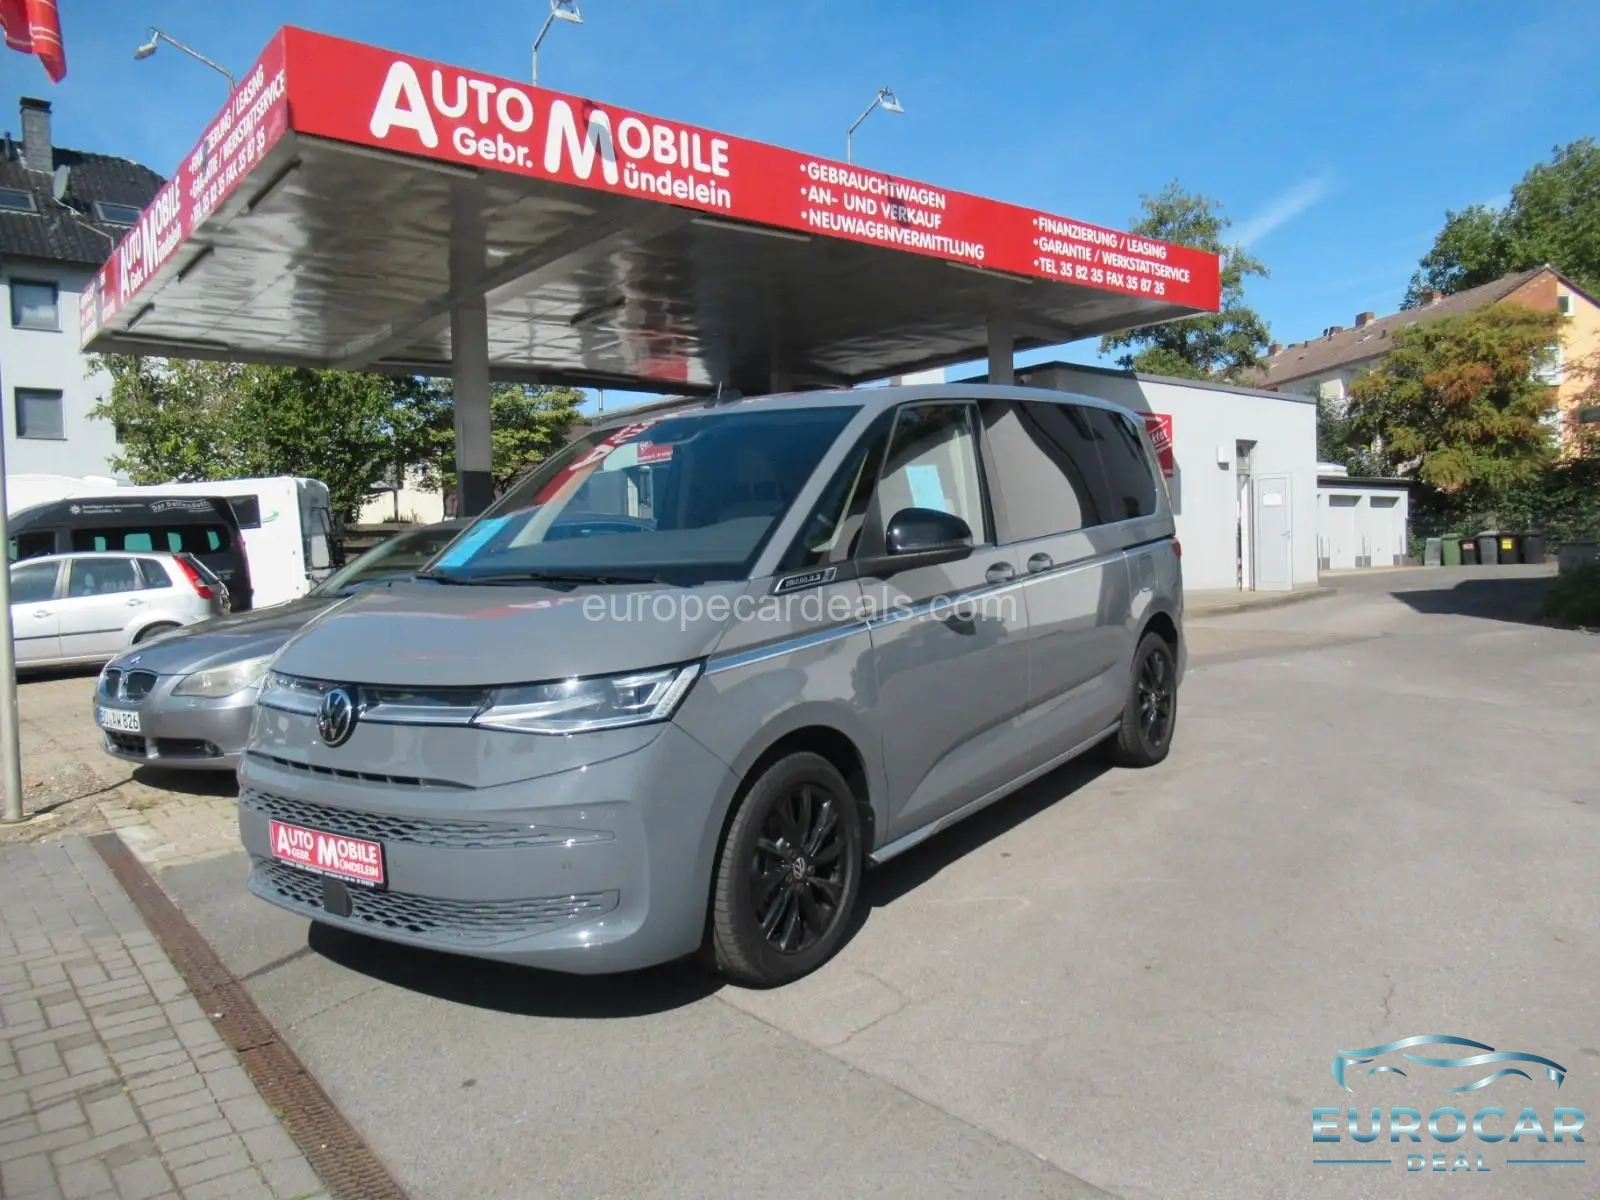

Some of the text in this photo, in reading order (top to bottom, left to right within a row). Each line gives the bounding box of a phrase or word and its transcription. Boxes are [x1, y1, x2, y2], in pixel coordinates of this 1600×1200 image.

[236, 64, 264, 116] LEASING
[369, 60, 731, 185] AUTO MOBILE
[452, 127, 534, 168] Gebr.
[807, 162, 946, 210] GEBRAUCHTWAGEN
[808, 185, 942, 230] AN- UND VERKAUF
[809, 208, 985, 261] NEUWAGENVERMITTLUNG
[1038, 216, 1118, 249] FINANZIERUNG
[1127, 239, 1167, 260] LEASING
[1039, 236, 1092, 261] GARANTIE
[1102, 251, 1191, 283] WERKSTATTSERVICE
[1039, 257, 1165, 296] TEL 35 82 35 FAX 35 87 35
[277, 826, 378, 868] AUTO MOBILE
